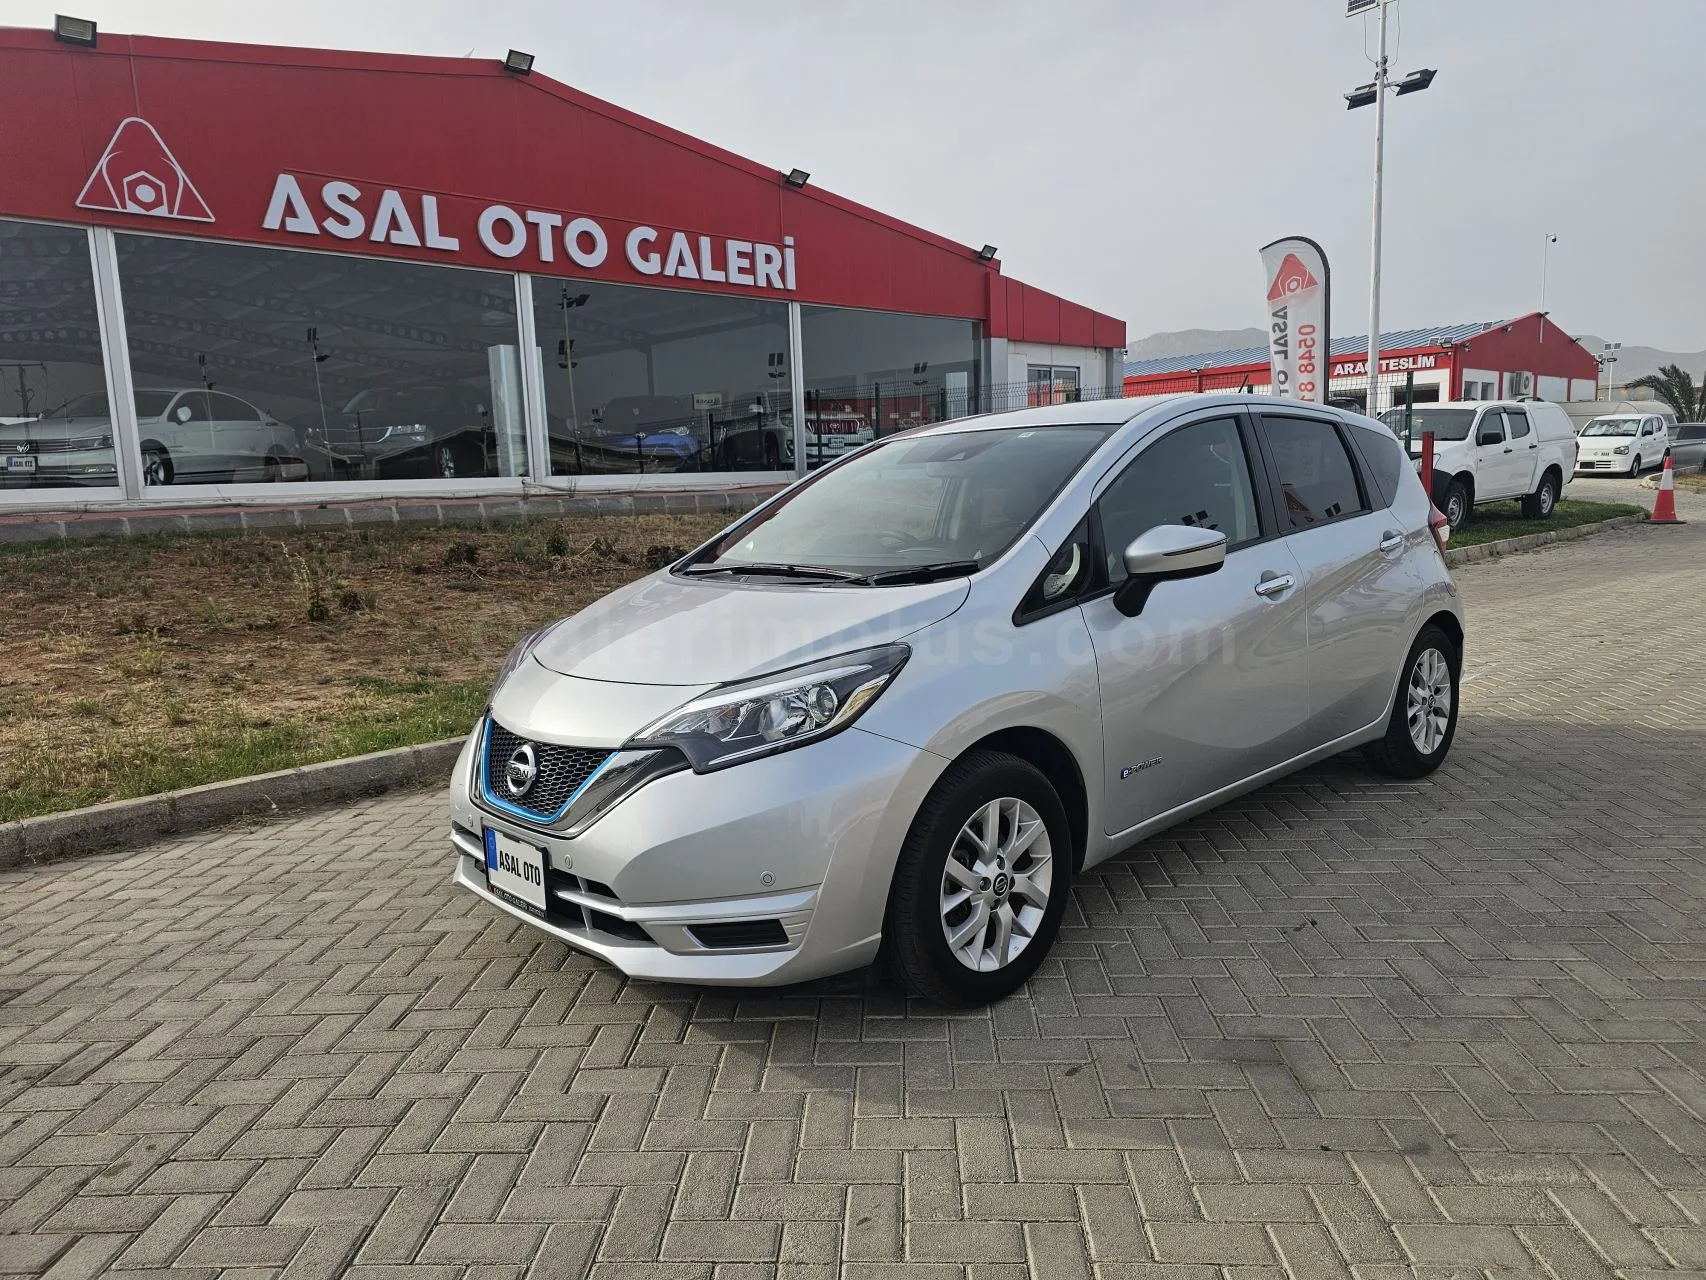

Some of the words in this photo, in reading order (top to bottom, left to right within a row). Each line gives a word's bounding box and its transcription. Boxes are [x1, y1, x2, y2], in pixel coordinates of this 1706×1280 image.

[262, 173, 459, 251] ASAL
[477, 204, 608, 268] OTO
[625, 226, 796, 291] GALERİ
[1380, 355, 1435, 372] TESLİM
[499, 850, 522, 877] ASAL
[523, 861, 541, 887] OTO
